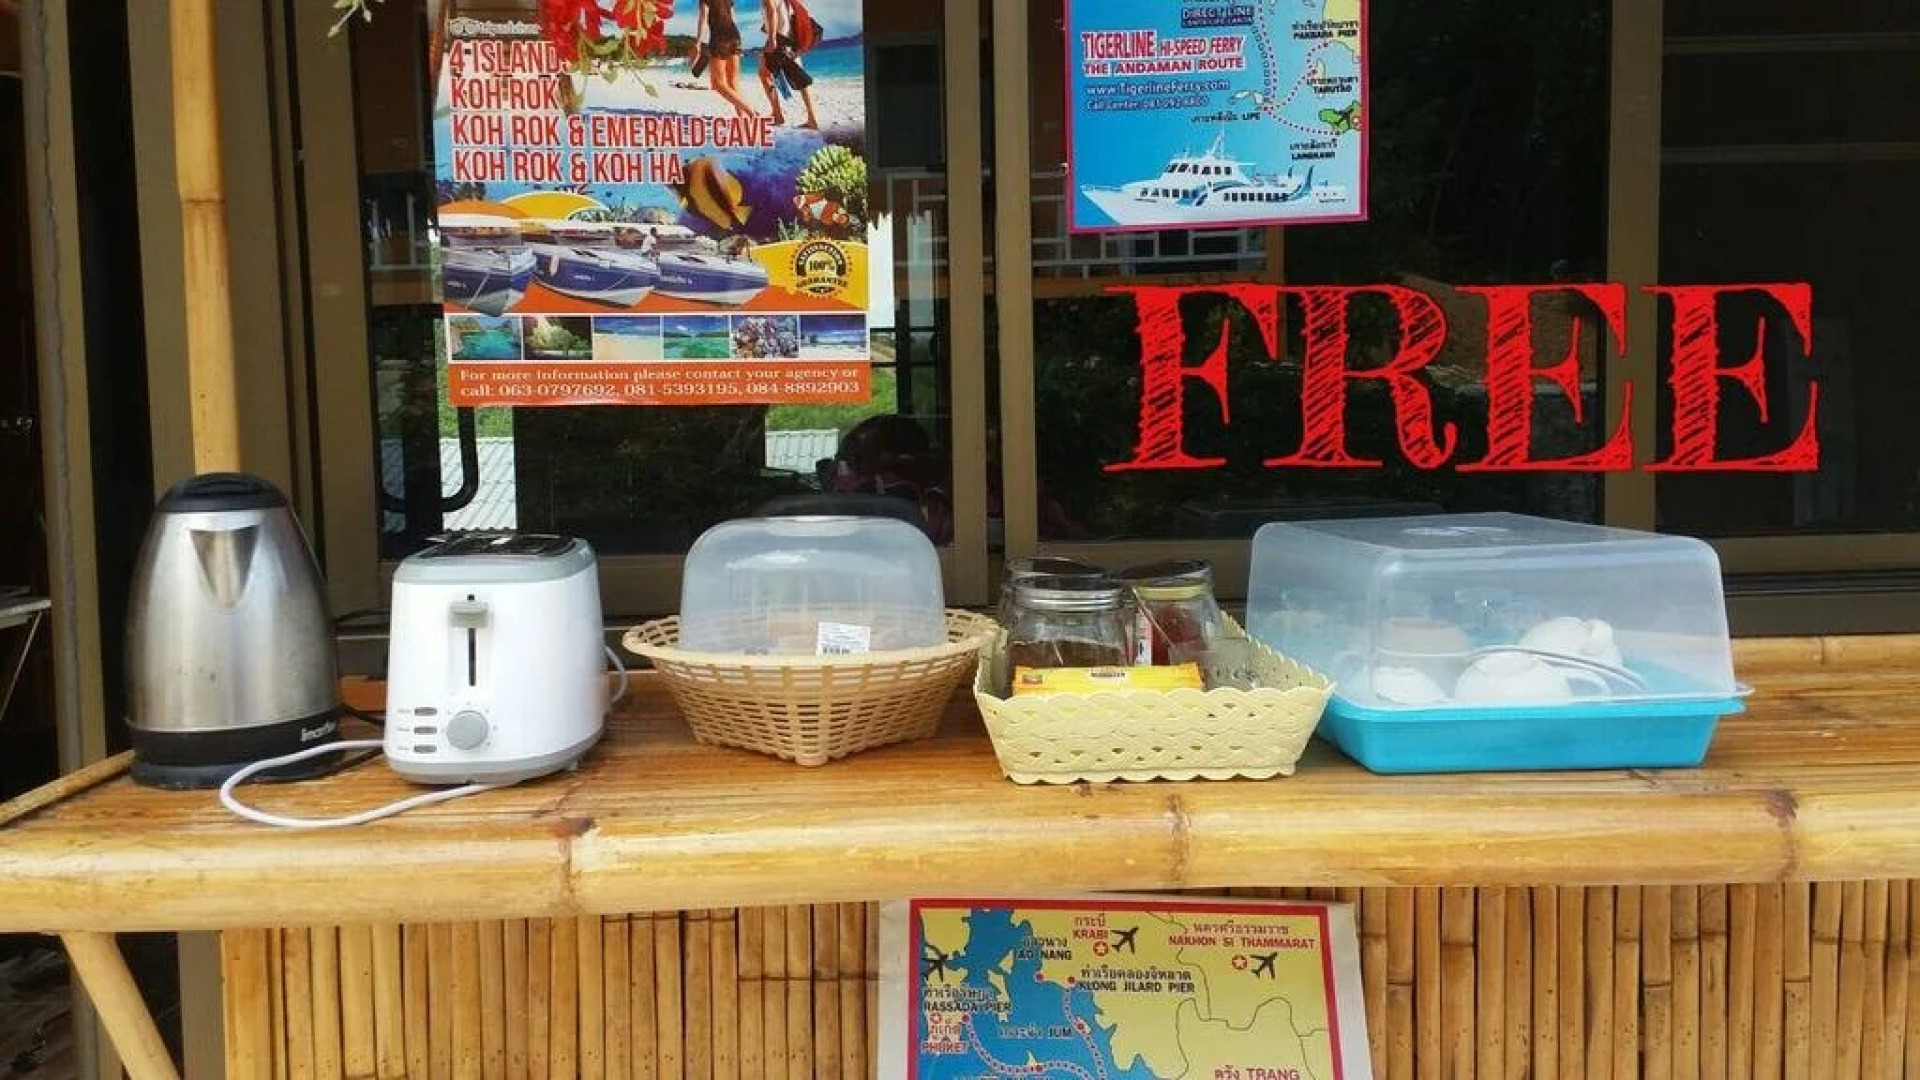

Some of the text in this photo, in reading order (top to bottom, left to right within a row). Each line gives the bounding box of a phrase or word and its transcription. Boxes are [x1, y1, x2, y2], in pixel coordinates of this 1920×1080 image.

[1082, 31, 1243, 58] TIGERLINE HI-SPEED FERRY
[450, 40, 465, 72] 4
[1083, 57, 1244, 75] THE ANDAMAN ROUTE
[451, 77, 559, 109] KOH ROK
[452, 115, 775, 148] KOH ROK & EMERALD CAVE
[454, 151, 685, 184] KOH ROK & KOH HA
[460, 368, 858, 384] For more information please contact your agency or
[460, 383, 492, 397] call:
[1073, 929, 1109, 940] KRABI
[1169, 935, 1316, 949] NAKHON SI THAMMARAT
[1017, 949, 1073, 961] AO NANG
[1081, 981, 1117, 992] KLONG
[1168, 982, 1195, 993] PIER
[924, 1001, 1011, 1013] RASSADA PIER
[922, 1041, 967, 1052] PHUKET
[1245, 1067, 1300, 1080] TRANG
